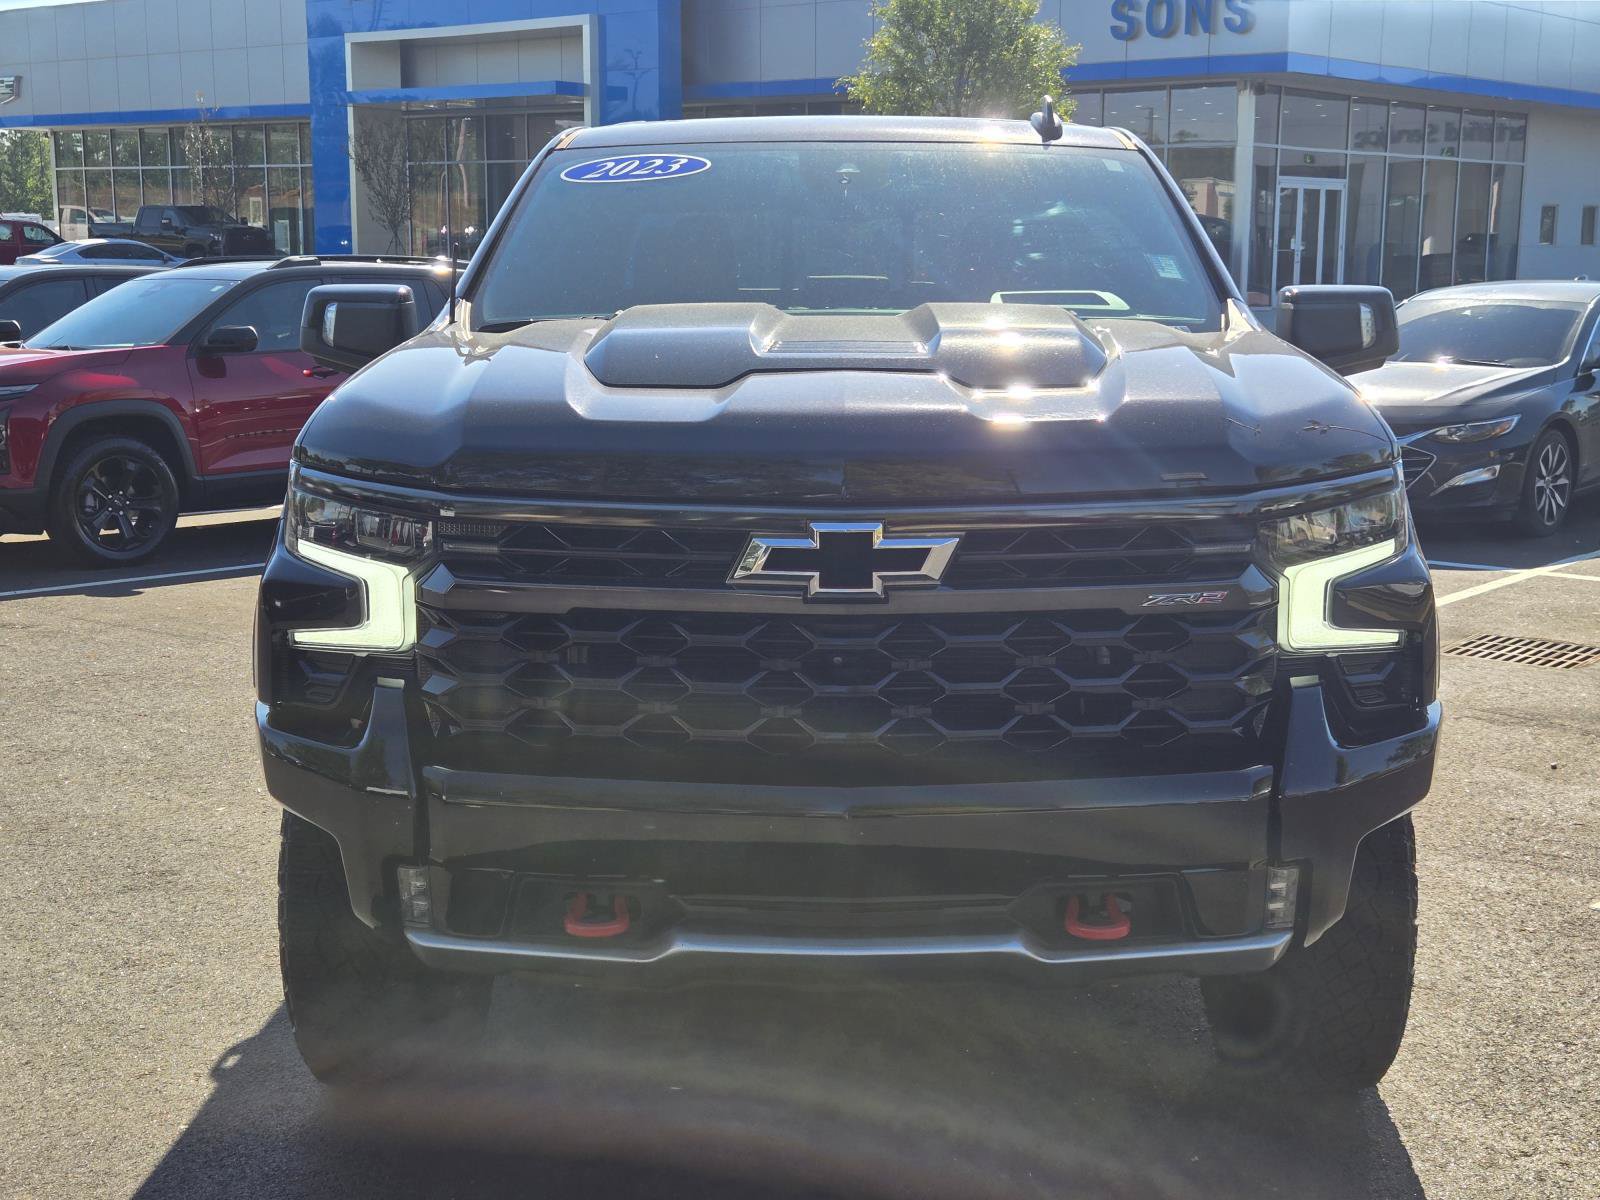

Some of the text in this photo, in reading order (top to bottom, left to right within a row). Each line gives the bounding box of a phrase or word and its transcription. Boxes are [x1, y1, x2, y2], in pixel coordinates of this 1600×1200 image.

[1110, 0, 1252, 41] SONS
[580, 158, 689, 179] 2023
[1141, 591, 1228, 607] ZR2
